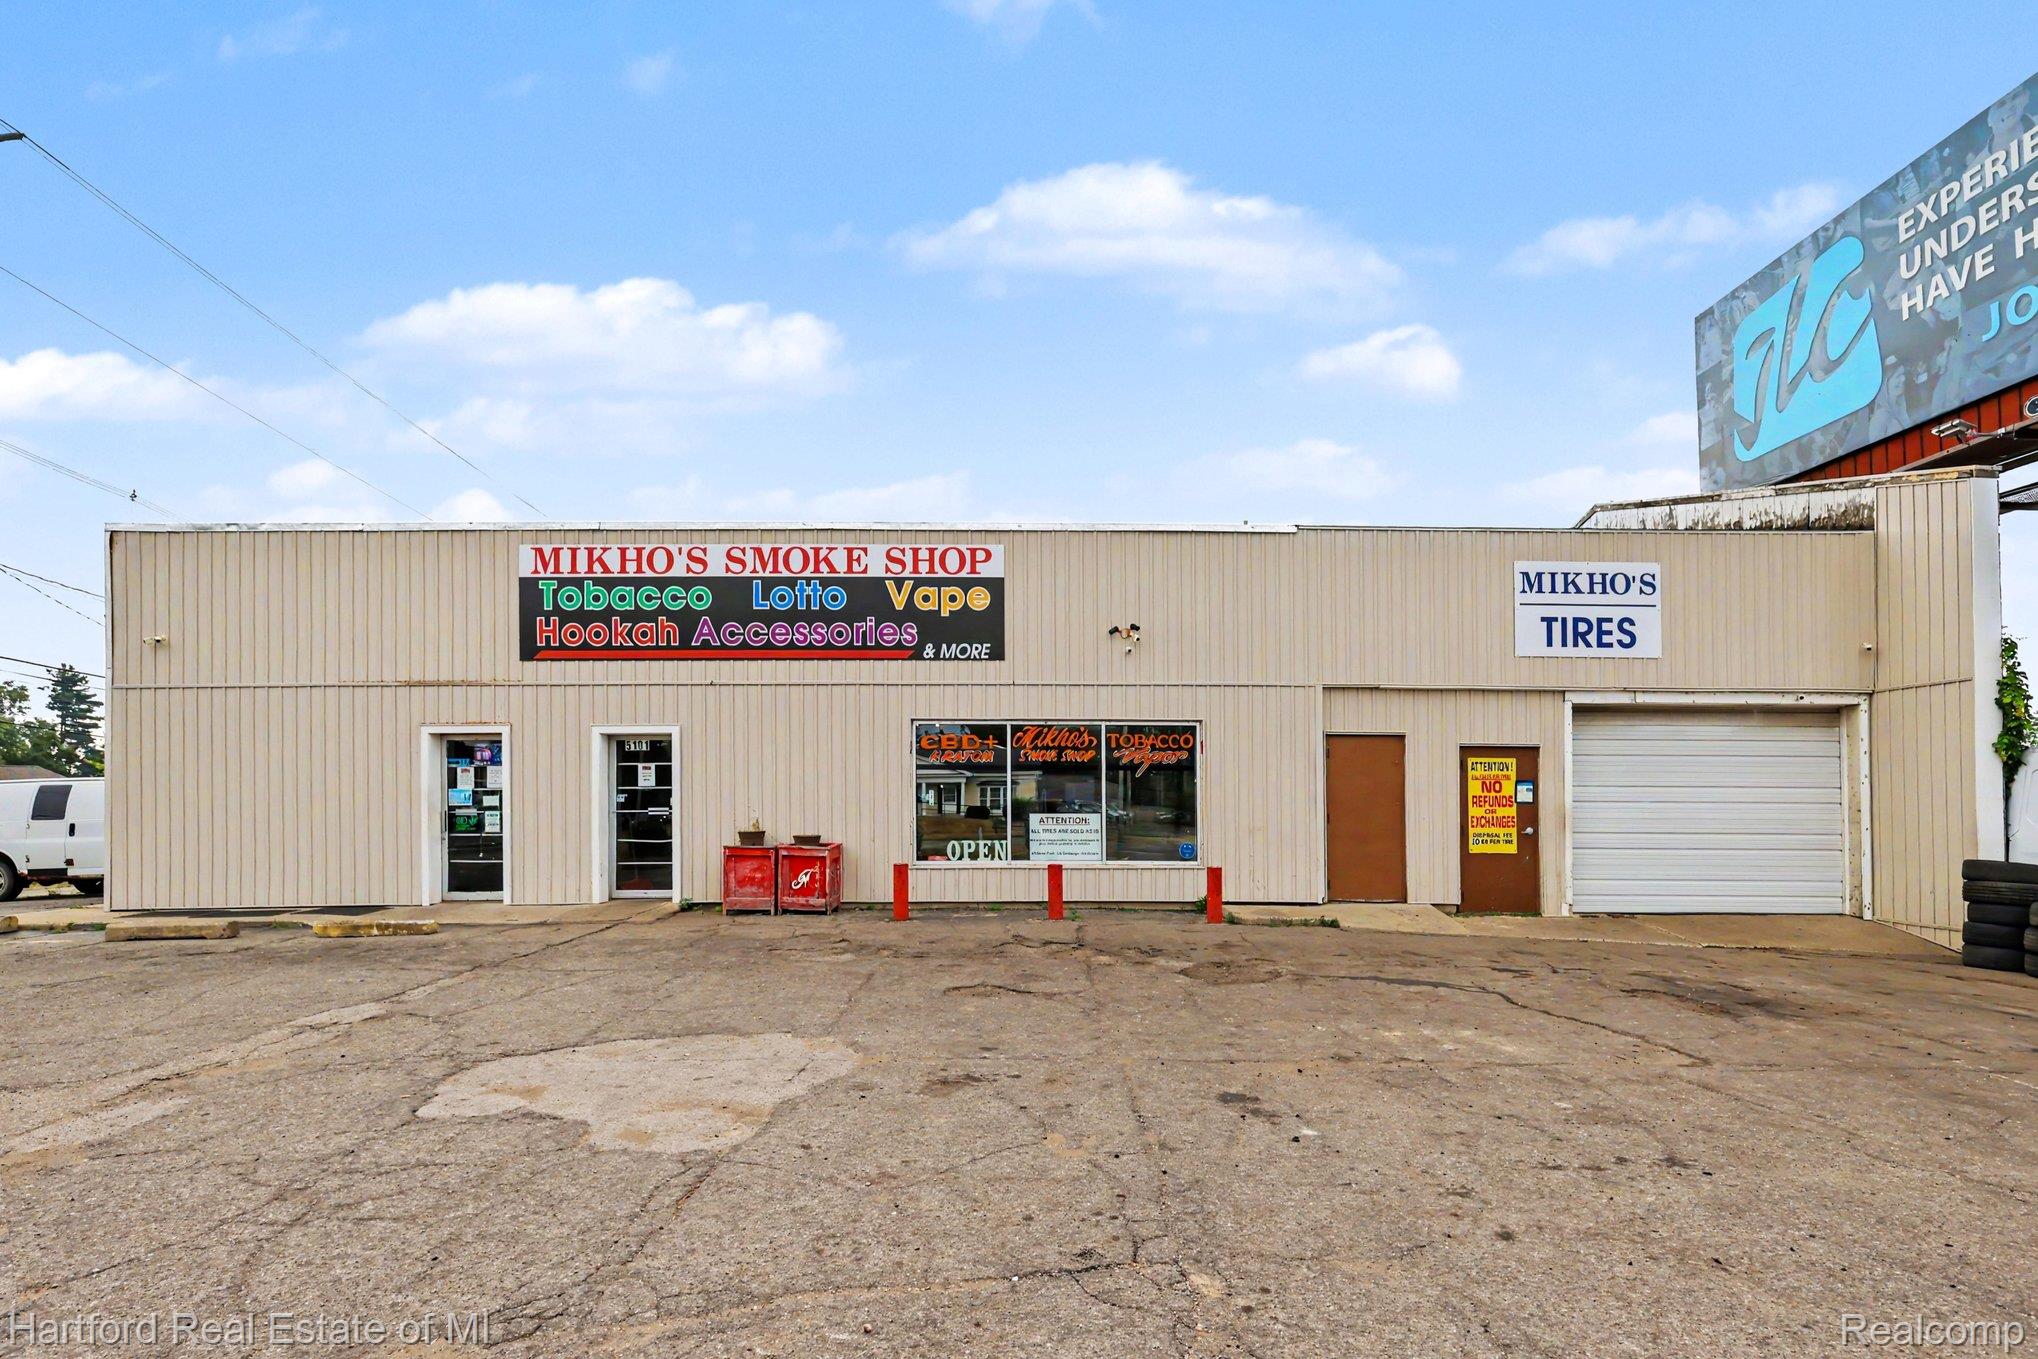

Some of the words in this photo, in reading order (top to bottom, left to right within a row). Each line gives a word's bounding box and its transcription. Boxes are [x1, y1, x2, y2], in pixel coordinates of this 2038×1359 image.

[1901, 243, 1996, 321] HAVE
[1982, 284, 2038, 342] JO
[530, 546, 709, 576] MIKHO'S
[724, 546, 869, 576] SMOKE
[884, 546, 993, 576] SHOP
[1519, 571, 1657, 596] MIKHO'S
[538, 580, 713, 611] Tobacco
[752, 580, 848, 611] Lotto
[885, 580, 992, 617] Vape
[536, 616, 680, 647] Hookah
[691, 616, 918, 647] Accessories
[1540, 616, 1637, 649] TIRES
[923, 644, 937, 659] &
[940, 643, 991, 659] MORE
[626, 741, 649, 751] 5101
[1107, 733, 1194, 749] TOBACCO
[1470, 761, 1514, 772] ATTENTION!
[1481, 780, 1503, 793] NO
[1471, 795, 1514, 808] REFUNDS
[1039, 816, 1090, 824] ATTENTION:
[1470, 816, 1516, 828] EXCHANGES
[946, 840, 1008, 861] OPEN
